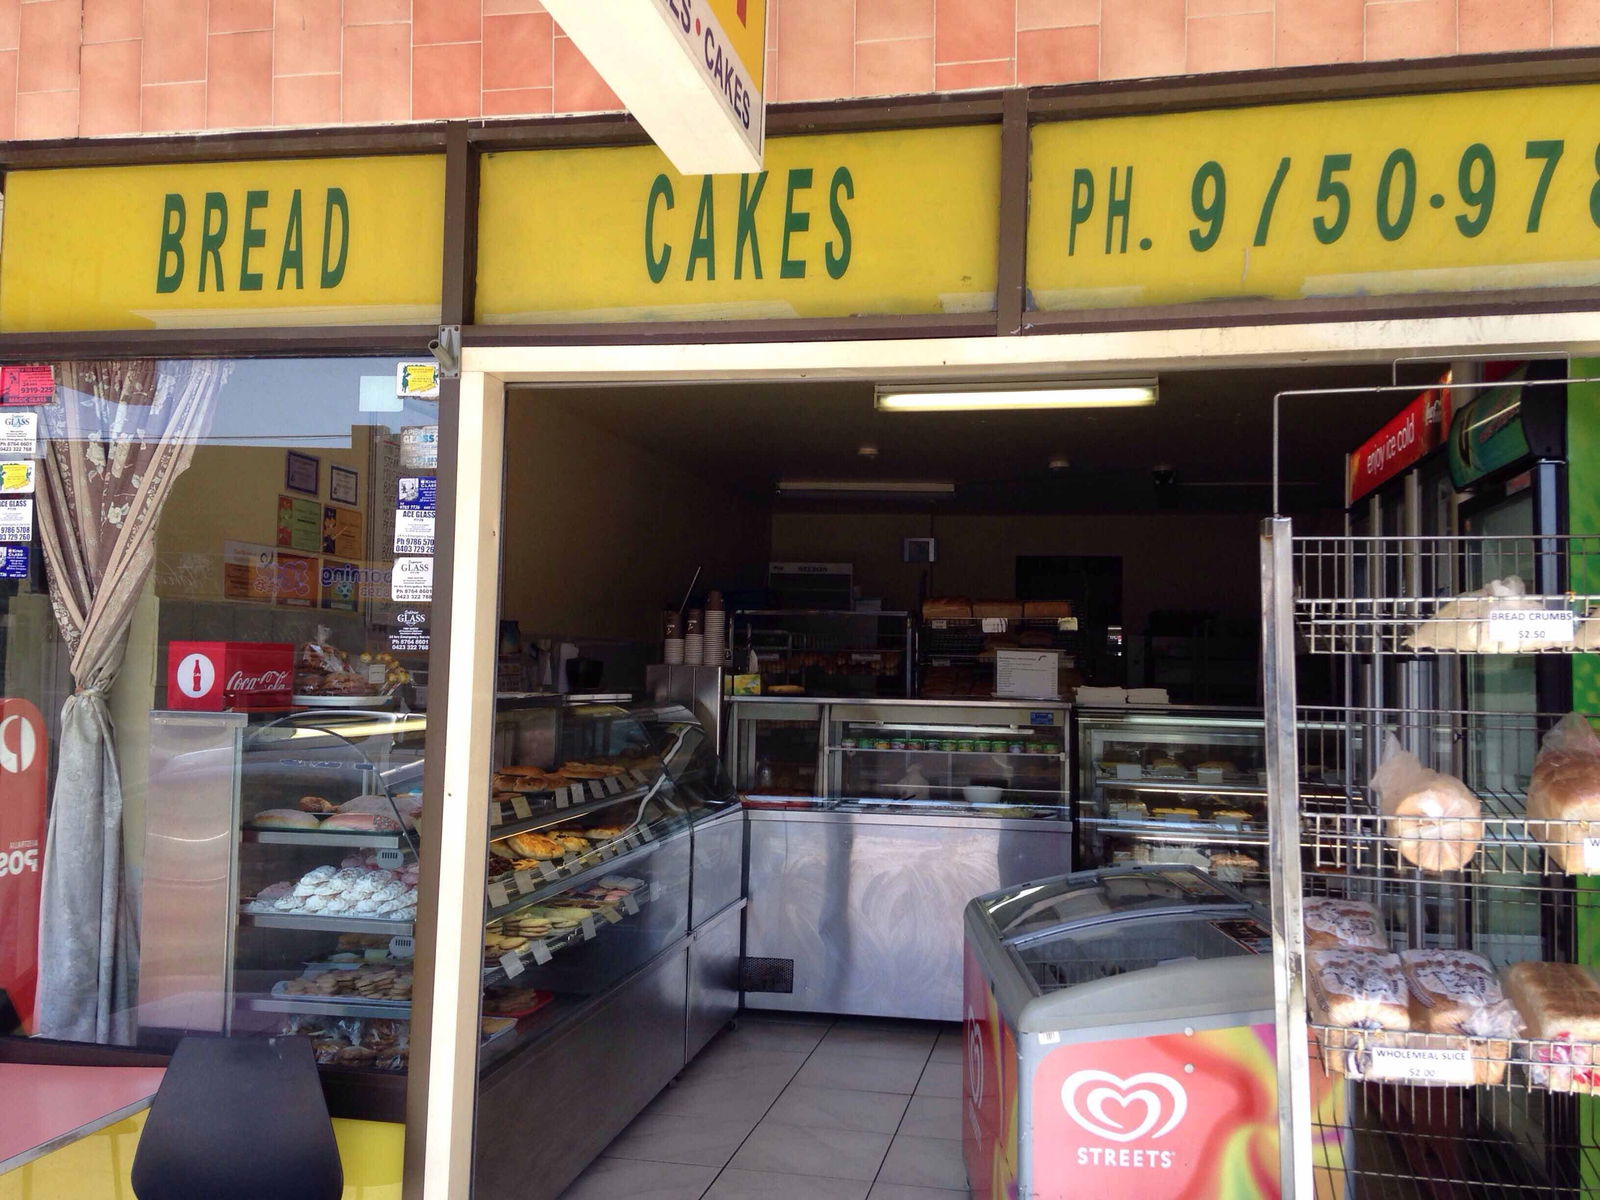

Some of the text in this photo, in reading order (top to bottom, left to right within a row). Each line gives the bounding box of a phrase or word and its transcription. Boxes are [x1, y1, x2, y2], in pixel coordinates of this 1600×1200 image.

[664, 0, 751, 130] ES CAKES
[1068, 165, 1153, 257] PH.
[644, 166, 855, 284] CAKES
[156, 187, 350, 294] BREAD
[4, 418, 30, 426] GLASS
[1366, 445, 1387, 475] enjoy
[1386, 436, 1397, 459] ice
[1397, 413, 1414, 452] cold
[416, 511, 436, 519] GLASS
[422, 538, 435, 546] 570
[401, 564, 429, 572] GLASS
[397, 614, 426, 623] GLASS
[1491, 612, 1572, 621] BREAD CRUMBS
[1518, 630, 1546, 639] $2.50
[1376, 1050, 1465, 1061] WHOLEMEAL SLICE
[1077, 1147, 1172, 1168] STREETS
